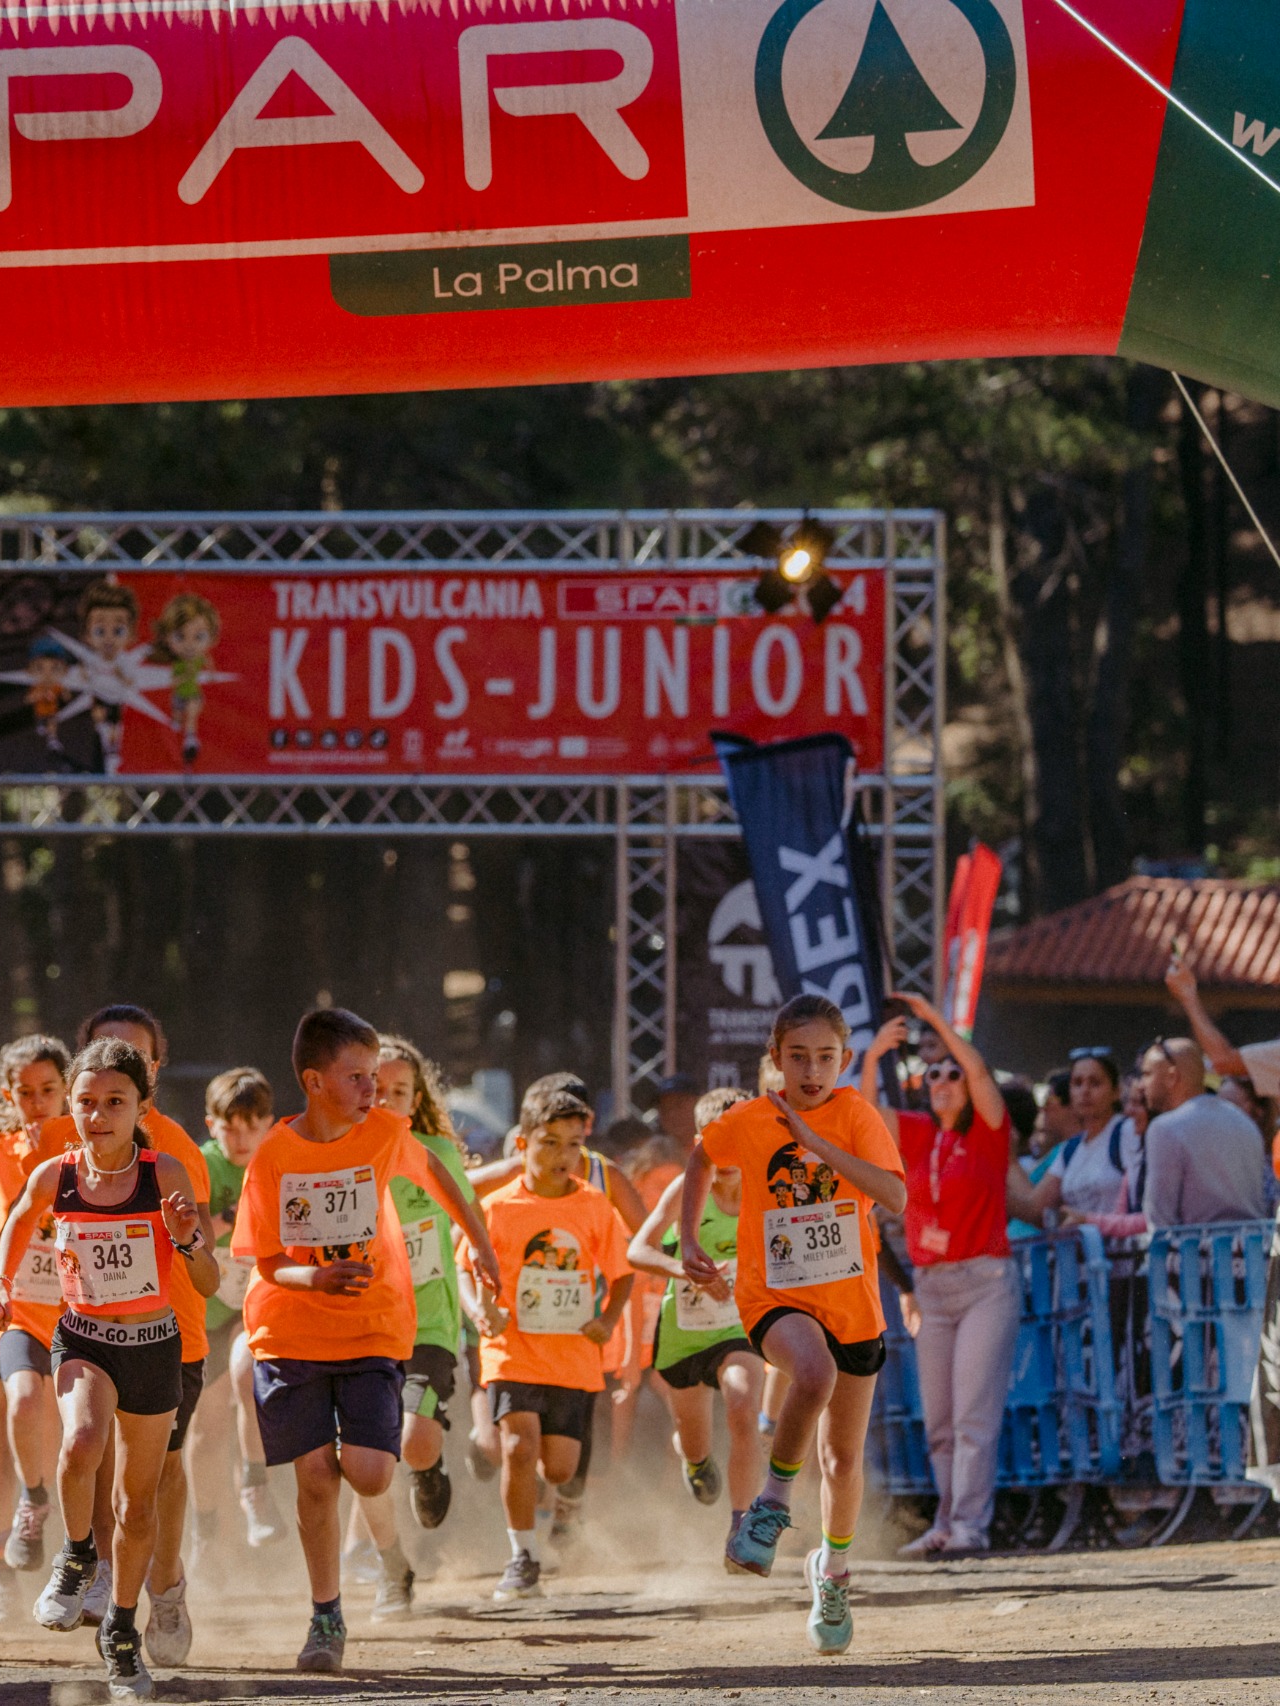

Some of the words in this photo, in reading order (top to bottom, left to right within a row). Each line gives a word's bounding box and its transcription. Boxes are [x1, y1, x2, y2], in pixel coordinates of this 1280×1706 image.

[433, 266, 484, 299] La
[497, 259, 640, 296] Palma
[271, 578, 544, 620] TRANSVULCANIA
[594, 584, 717, 614] SPAR
[269, 624, 869, 720] KIDS-JUNIOR
[324, 1188, 357, 1214] 371
[84, 1231, 113, 1240] SPAR
[804, 1222, 842, 1250] 338
[31, 1255, 60, 1277] 34
[92, 1243, 133, 1270] 343
[803, 1252, 825, 1263] MILEY
[103, 1271, 128, 1282] DAINA
[552, 1288, 580, 1308] 374
